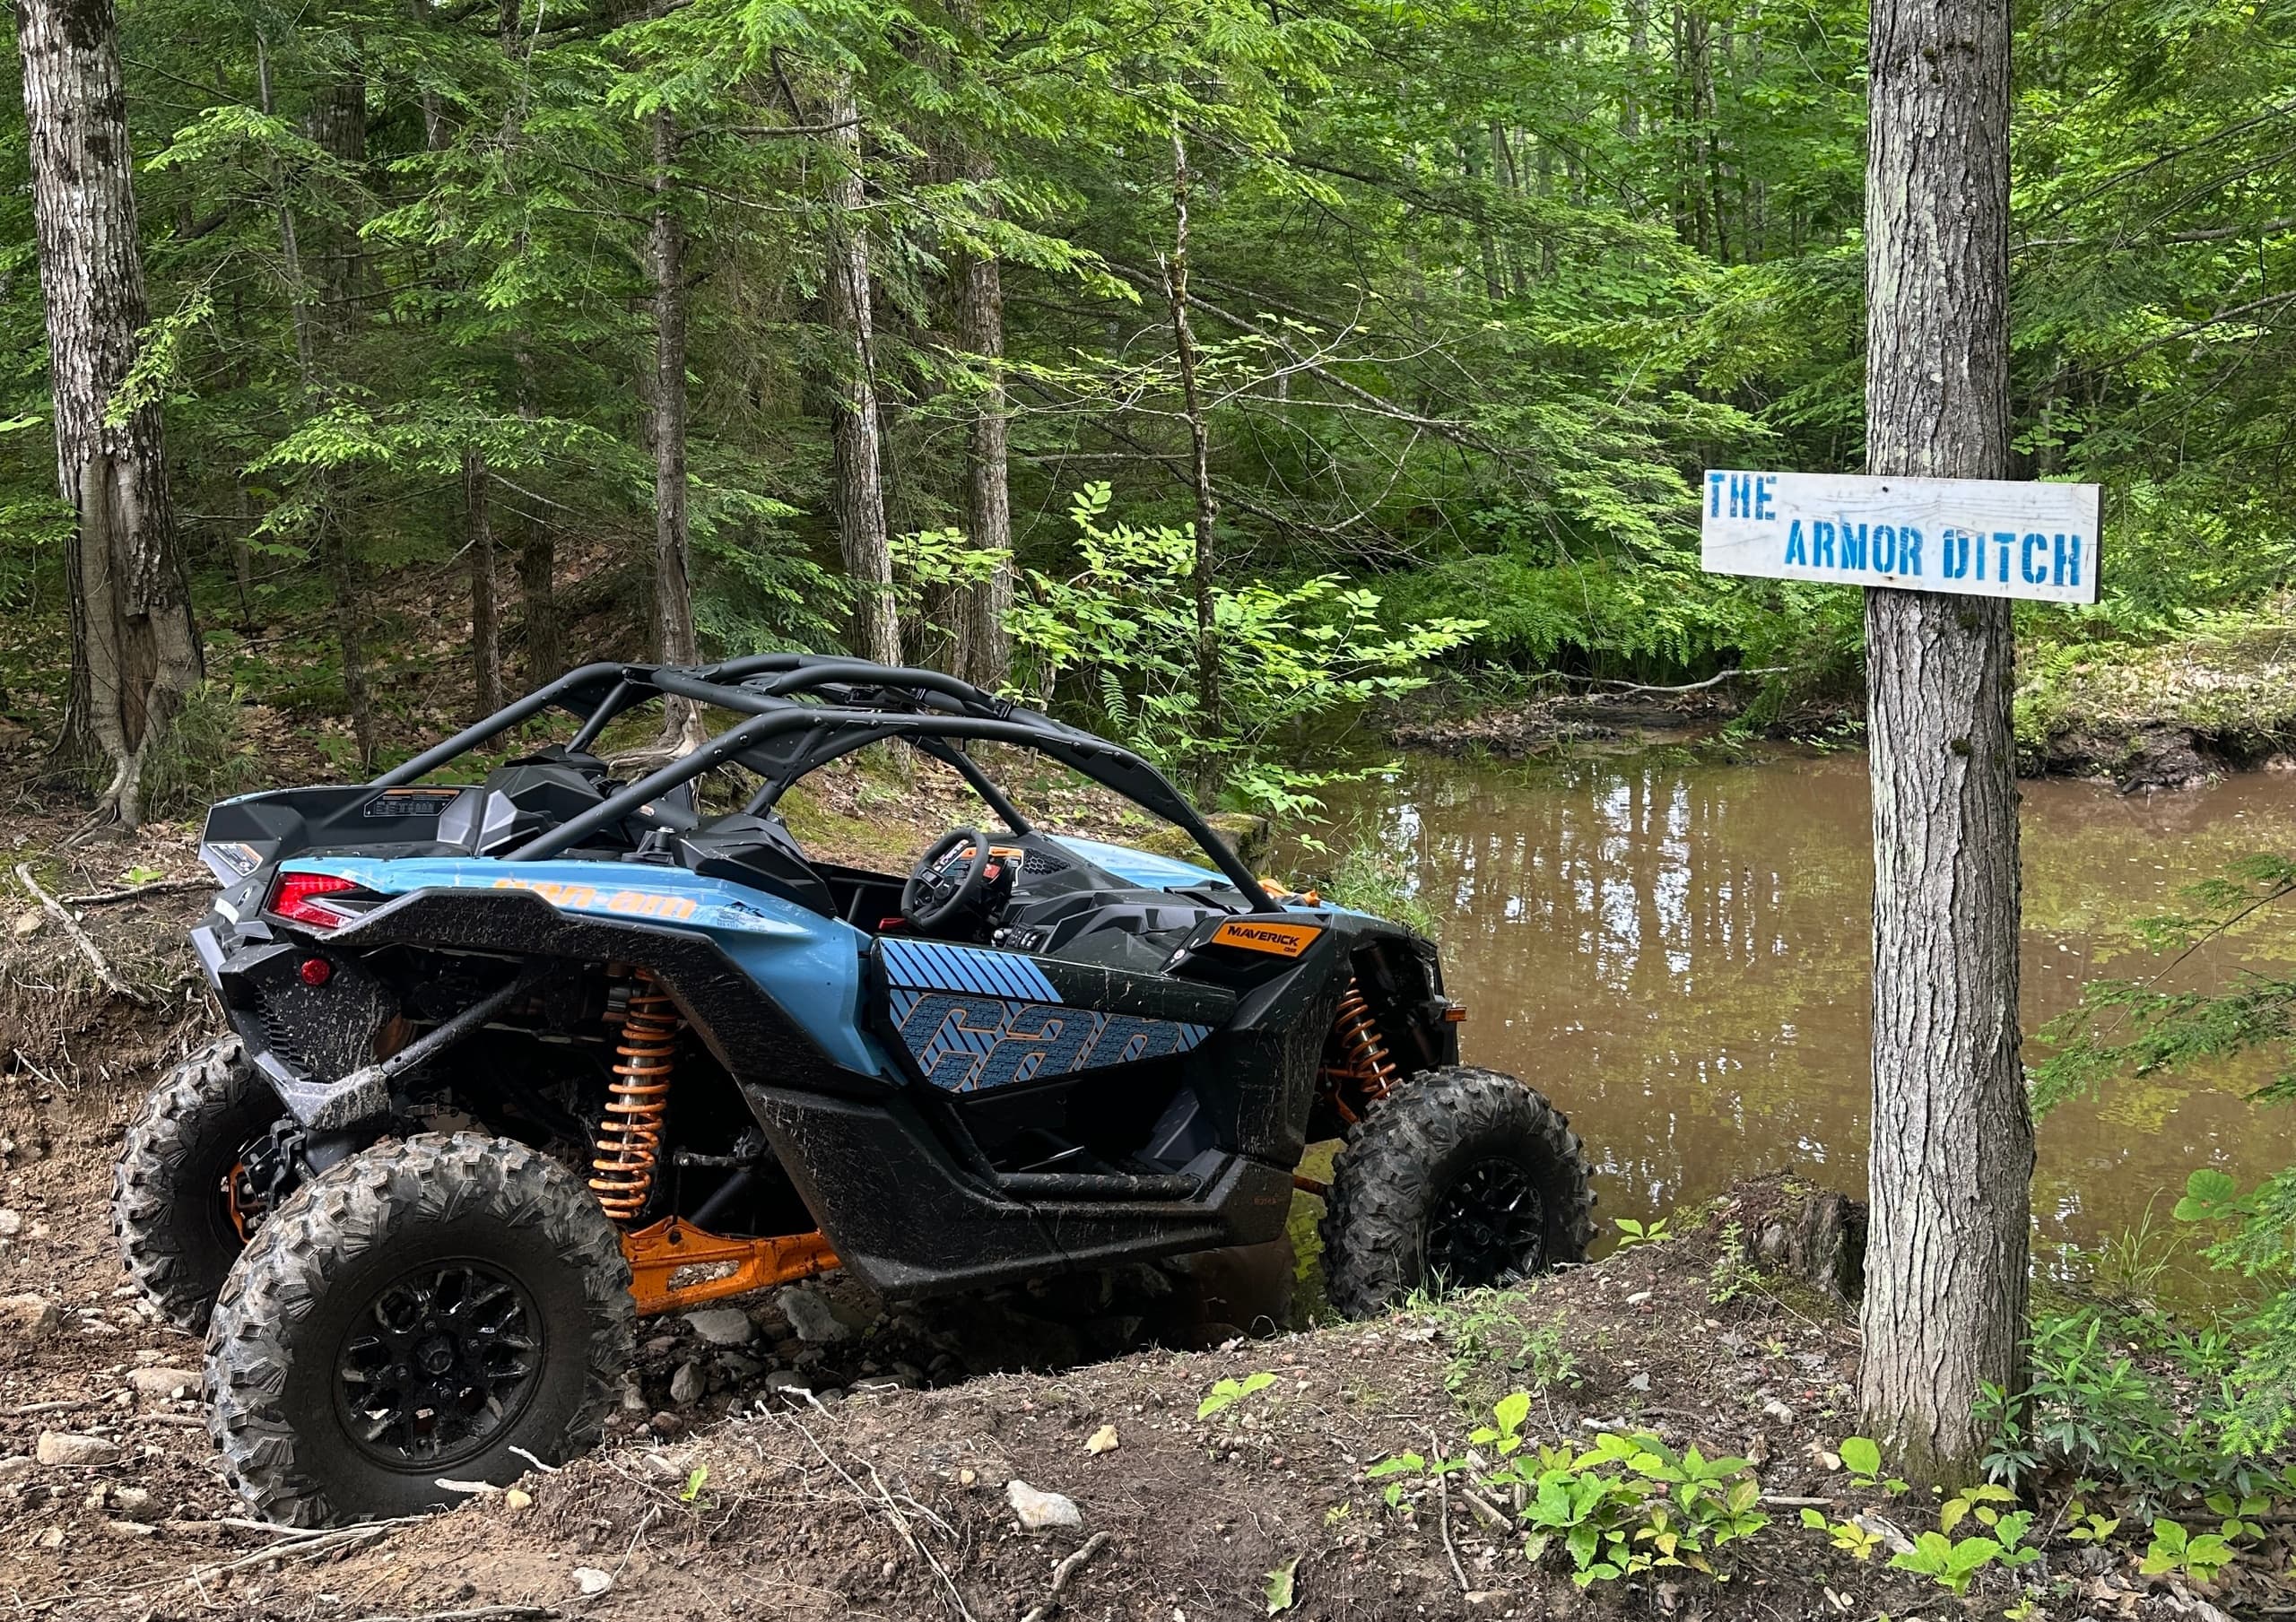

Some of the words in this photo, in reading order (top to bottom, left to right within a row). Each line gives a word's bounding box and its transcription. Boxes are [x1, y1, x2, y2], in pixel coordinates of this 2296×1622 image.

[1709, 473, 1778, 520] THE
[1784, 519, 1924, 576] ARMOR
[1943, 528, 2082, 586] DITCH
[1227, 925, 1300, 947] MAVERICK
